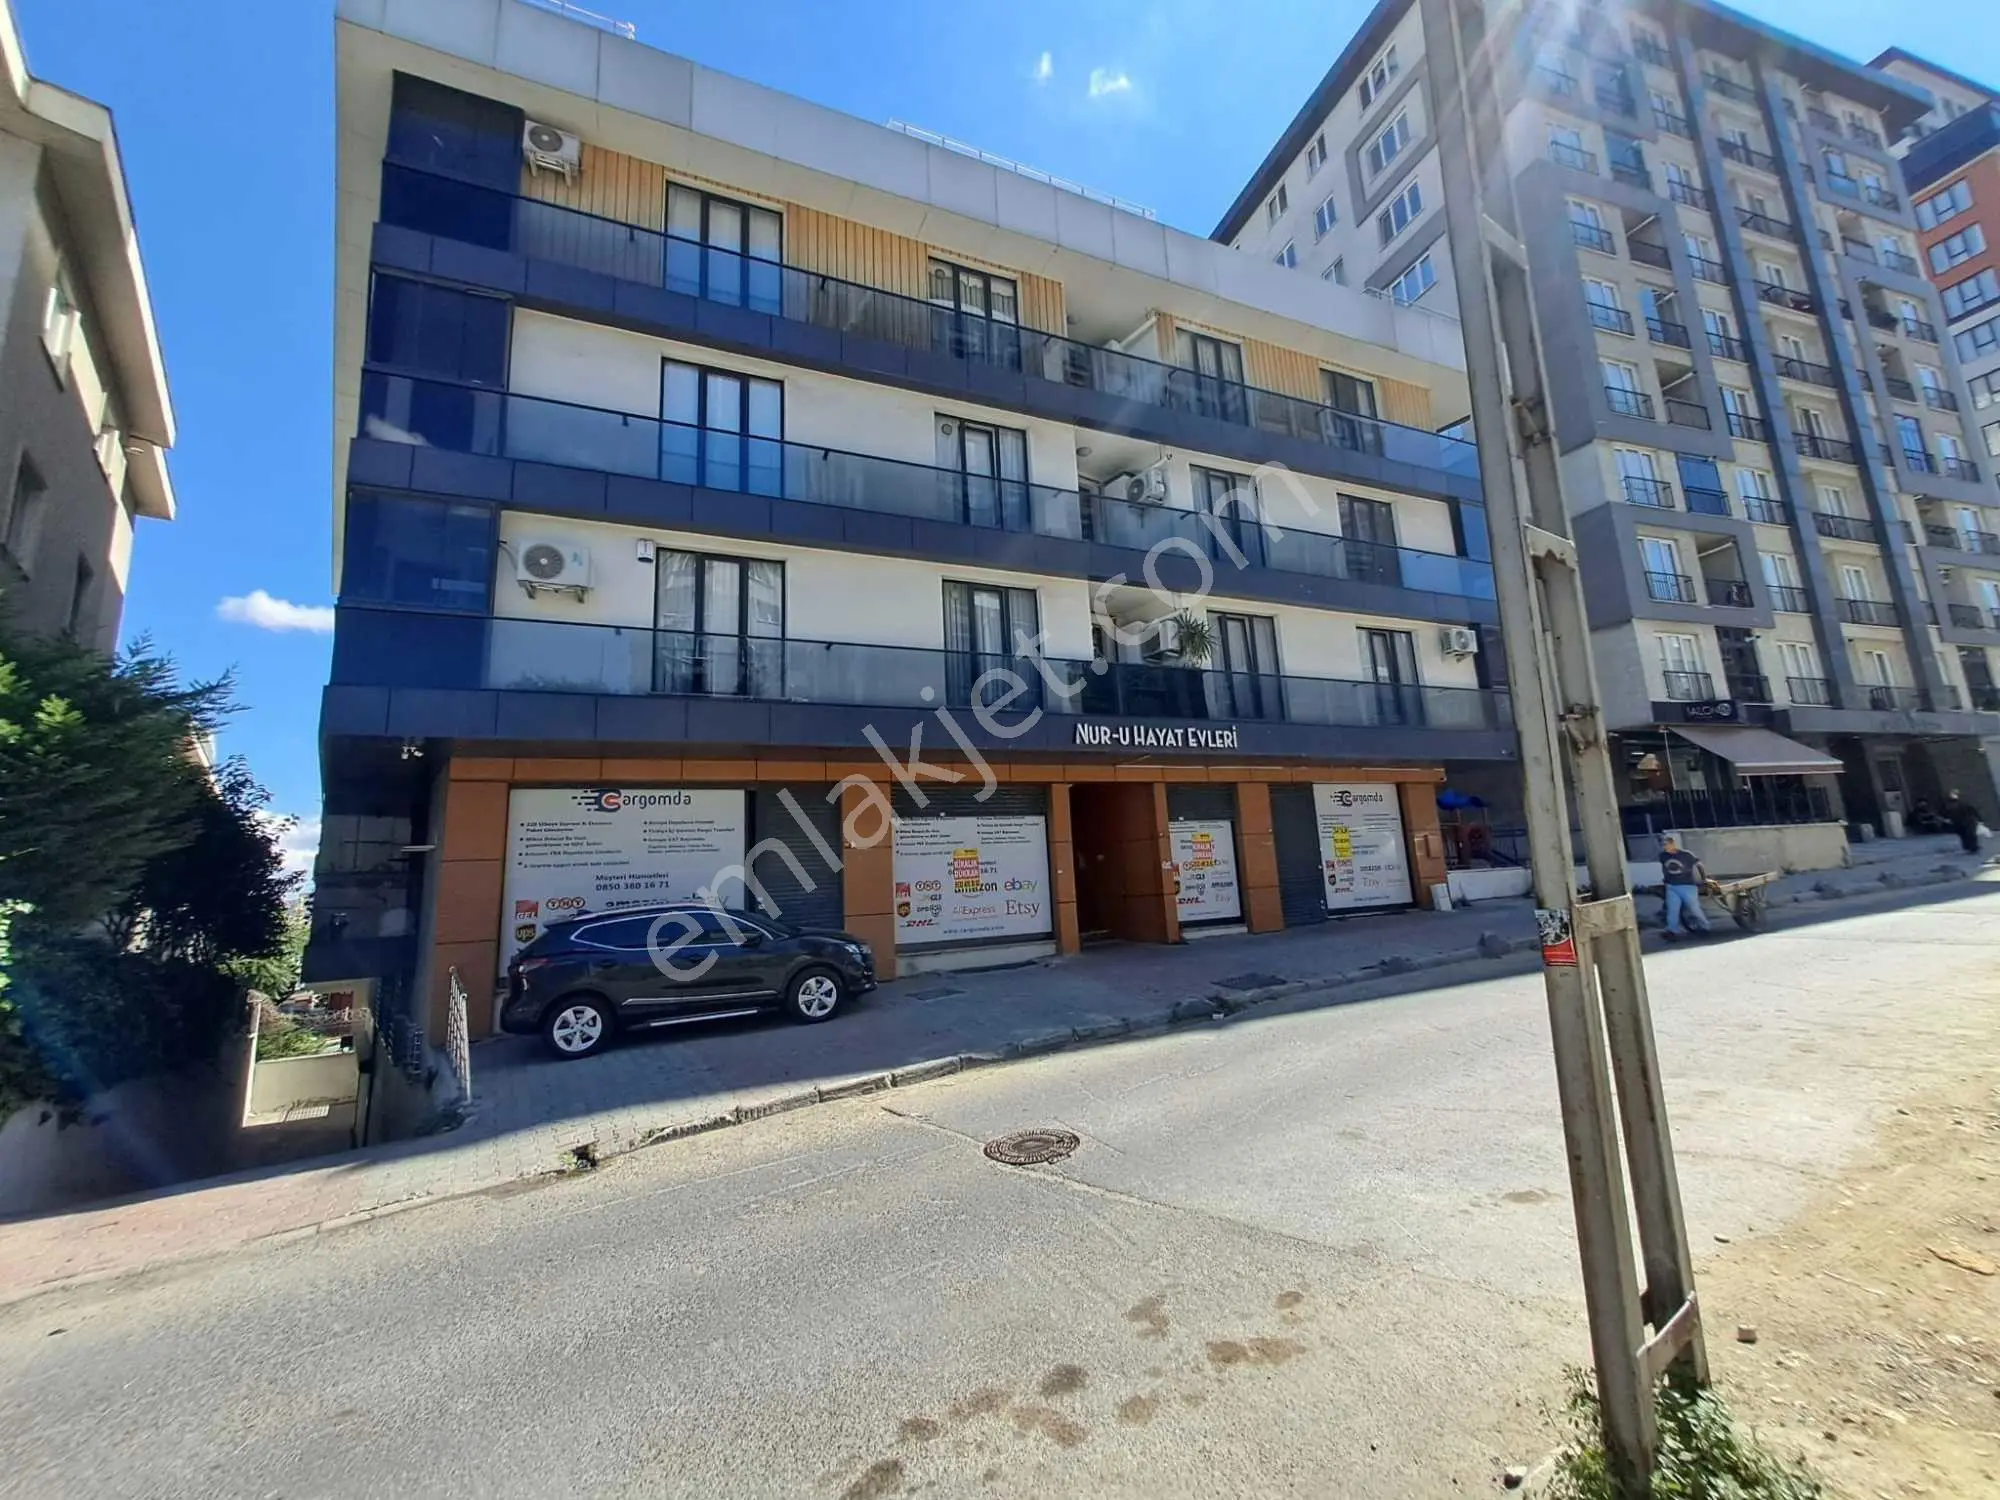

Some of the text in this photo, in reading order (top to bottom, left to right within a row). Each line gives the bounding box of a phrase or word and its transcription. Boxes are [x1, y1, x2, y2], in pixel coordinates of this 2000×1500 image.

[1134, 725, 1183, 747] HAYAT
[1004, 878, 1038, 893] ebay
[1006, 900, 1040, 918] Etsy
